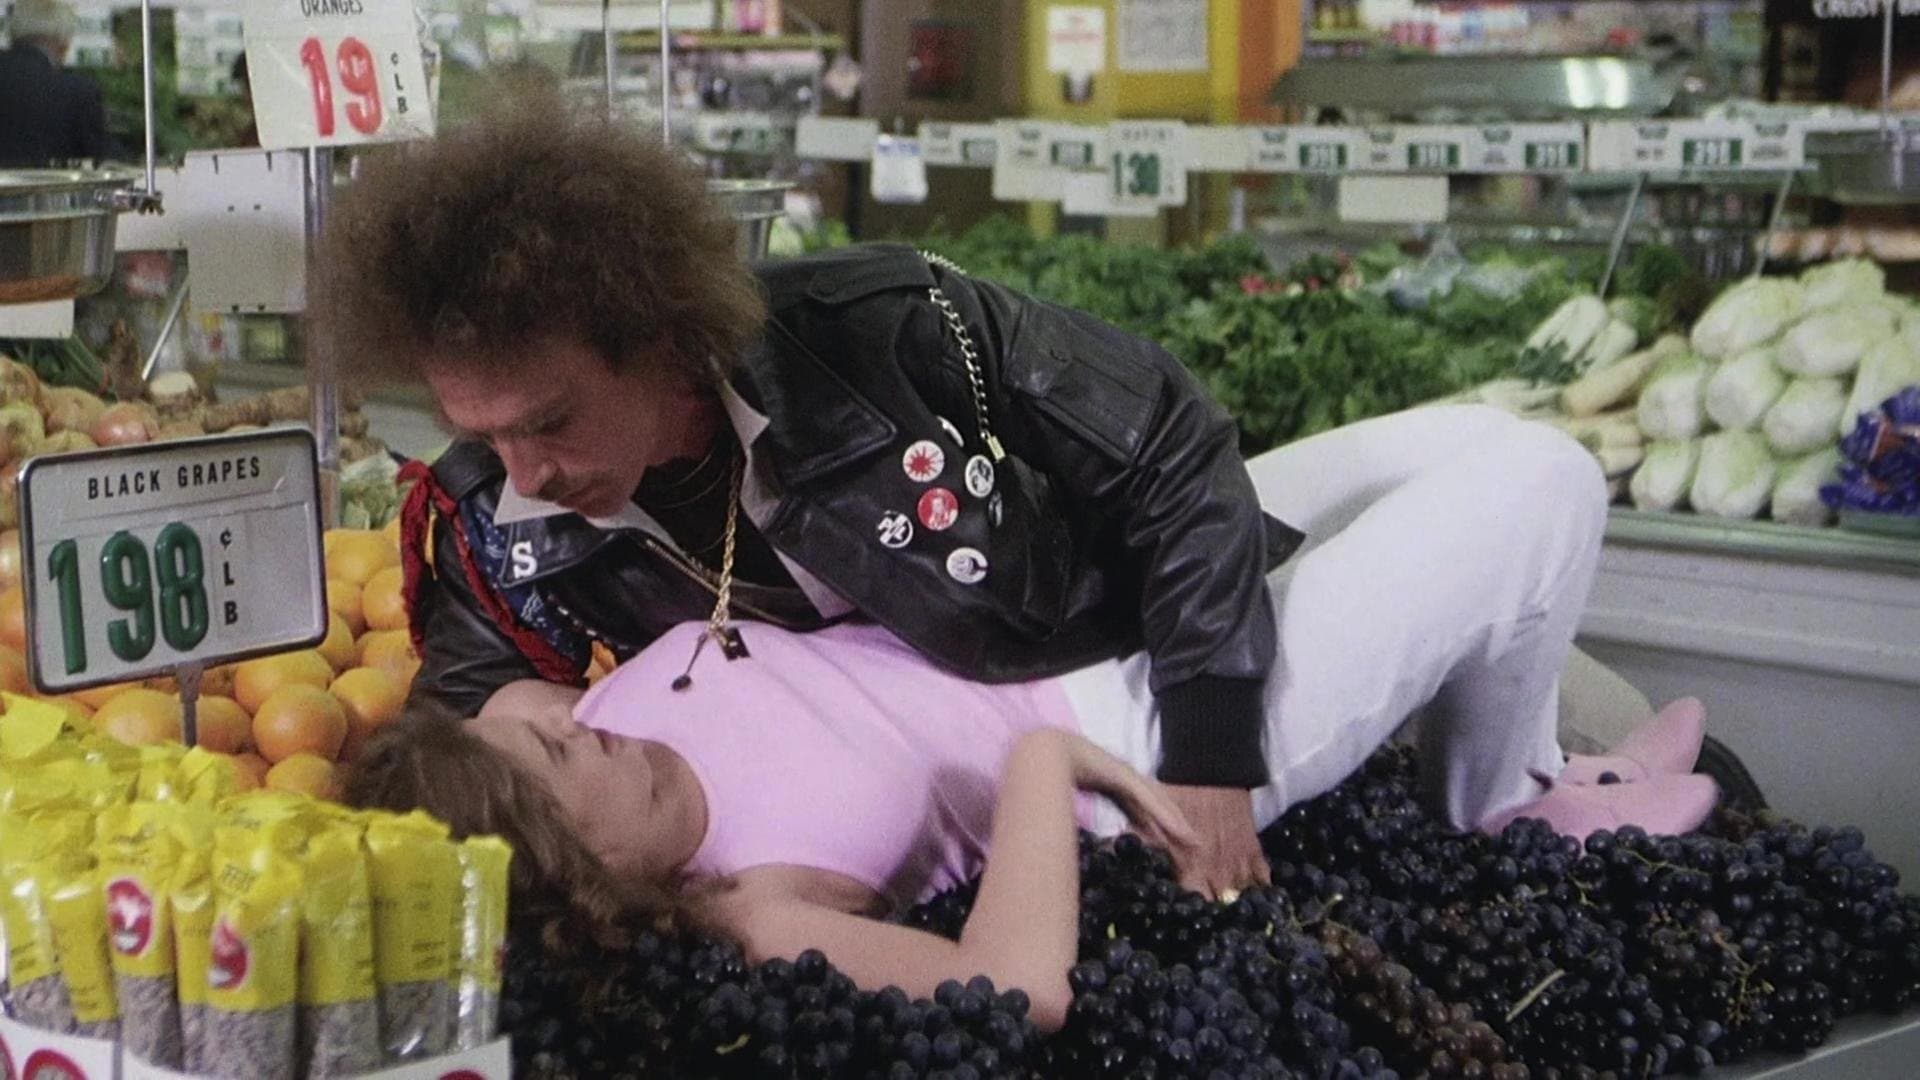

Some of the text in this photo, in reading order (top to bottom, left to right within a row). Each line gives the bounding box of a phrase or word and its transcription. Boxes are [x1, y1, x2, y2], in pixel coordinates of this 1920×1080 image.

[301, 0, 364, 17] ORANGES
[301, 37, 383, 137] 19
[88, 456, 261, 500] BLACK GRAPES
[511, 540, 538, 579] S
[48, 521, 209, 676] 198
